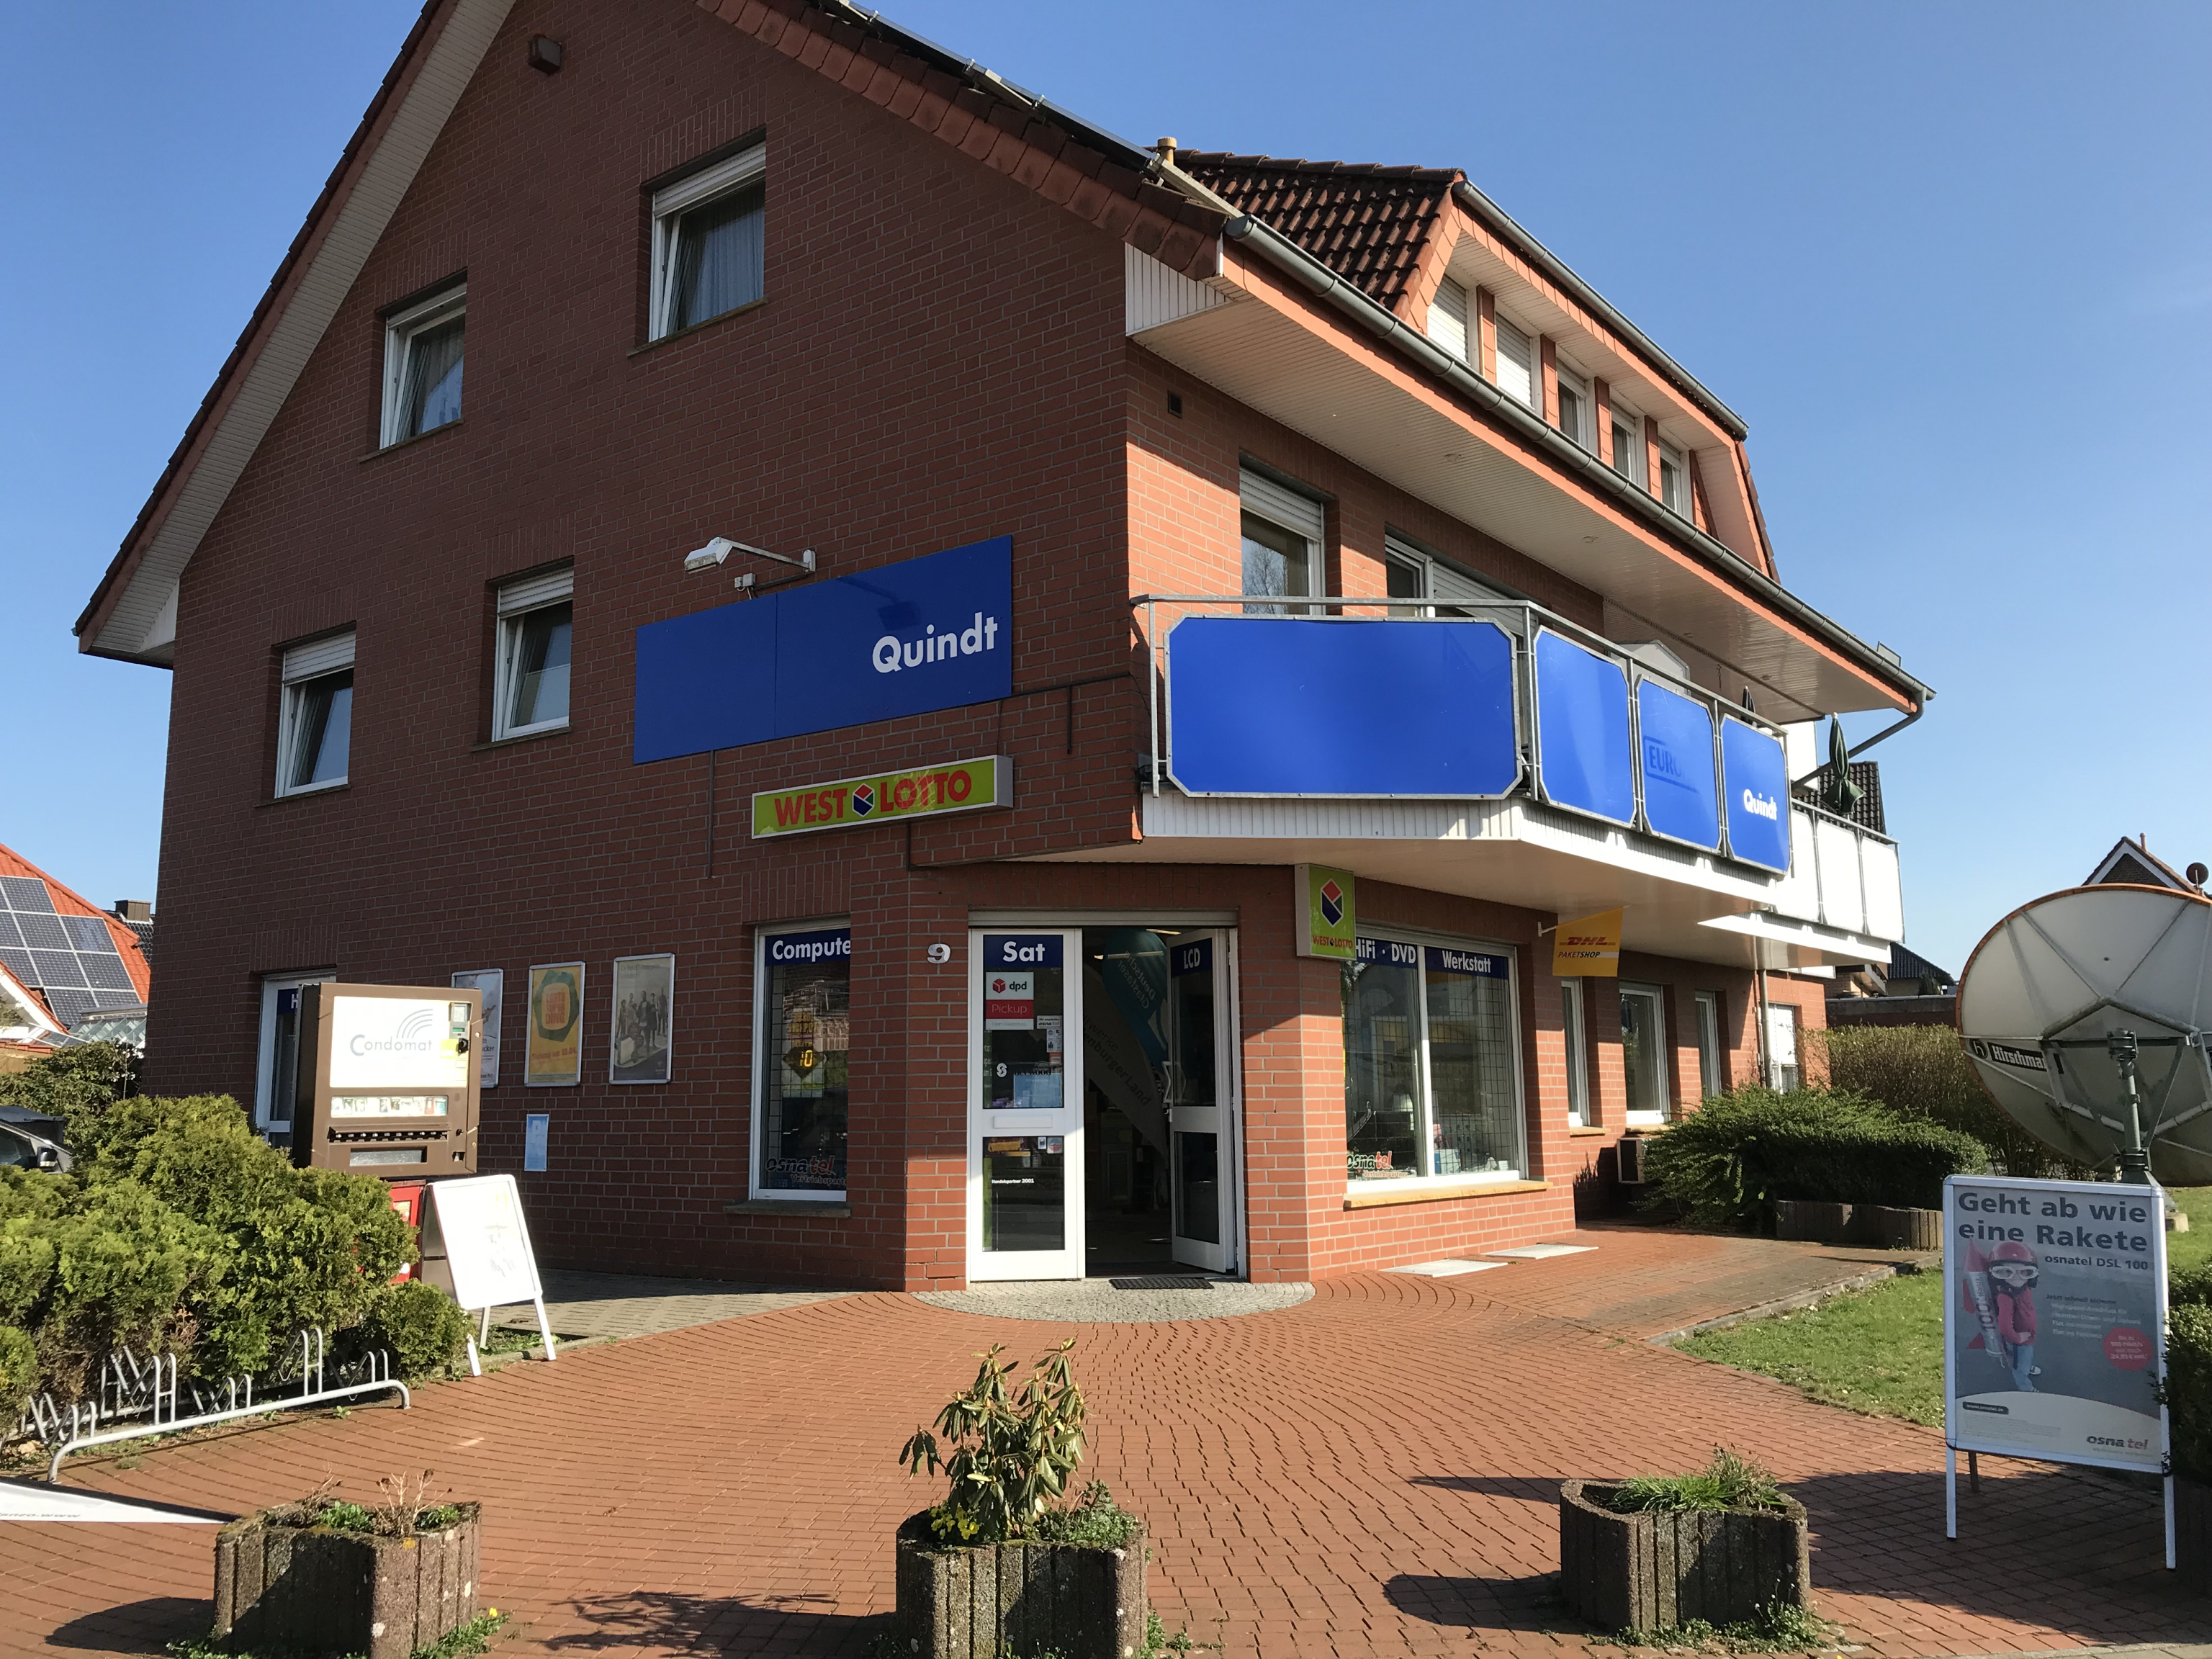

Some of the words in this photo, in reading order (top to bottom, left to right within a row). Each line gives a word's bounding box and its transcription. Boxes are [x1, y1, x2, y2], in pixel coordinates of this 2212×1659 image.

[872, 611, 998, 673] Quindt
[774, 788, 848, 827] WEST
[880, 770, 971, 812] LOTTO
[1743, 788, 1777, 821] Quindt
[772, 938, 850, 962] Compute
[1002, 940, 1046, 962] Sat
[1313, 935, 1330, 946] WEST
[1335, 938, 1353, 949] LOTTO
[1567, 936, 1608, 945] DHL
[927, 943, 951, 964] 9
[1183, 948, 1200, 970] LCD
[1391, 943, 1416, 963] DVD
[1442, 950, 1491, 974] Werkstatt
[1009, 981, 1028, 992] dpd
[992, 1004, 1028, 1015] Pickup
[350, 1034, 432, 1056] Condomat
[1959, 1192, 2031, 1215] Geht
[2041, 1197, 2079, 1218] ab
[2089, 1201, 2146, 1223] wie
[1959, 1220, 2024, 1242] eine
[2036, 1224, 2147, 1252] Rakete
[2045, 1255, 2092, 1266] osnatel
[2096, 1258, 2121, 1268] DSL
[2125, 1260, 2148, 1270] 100
